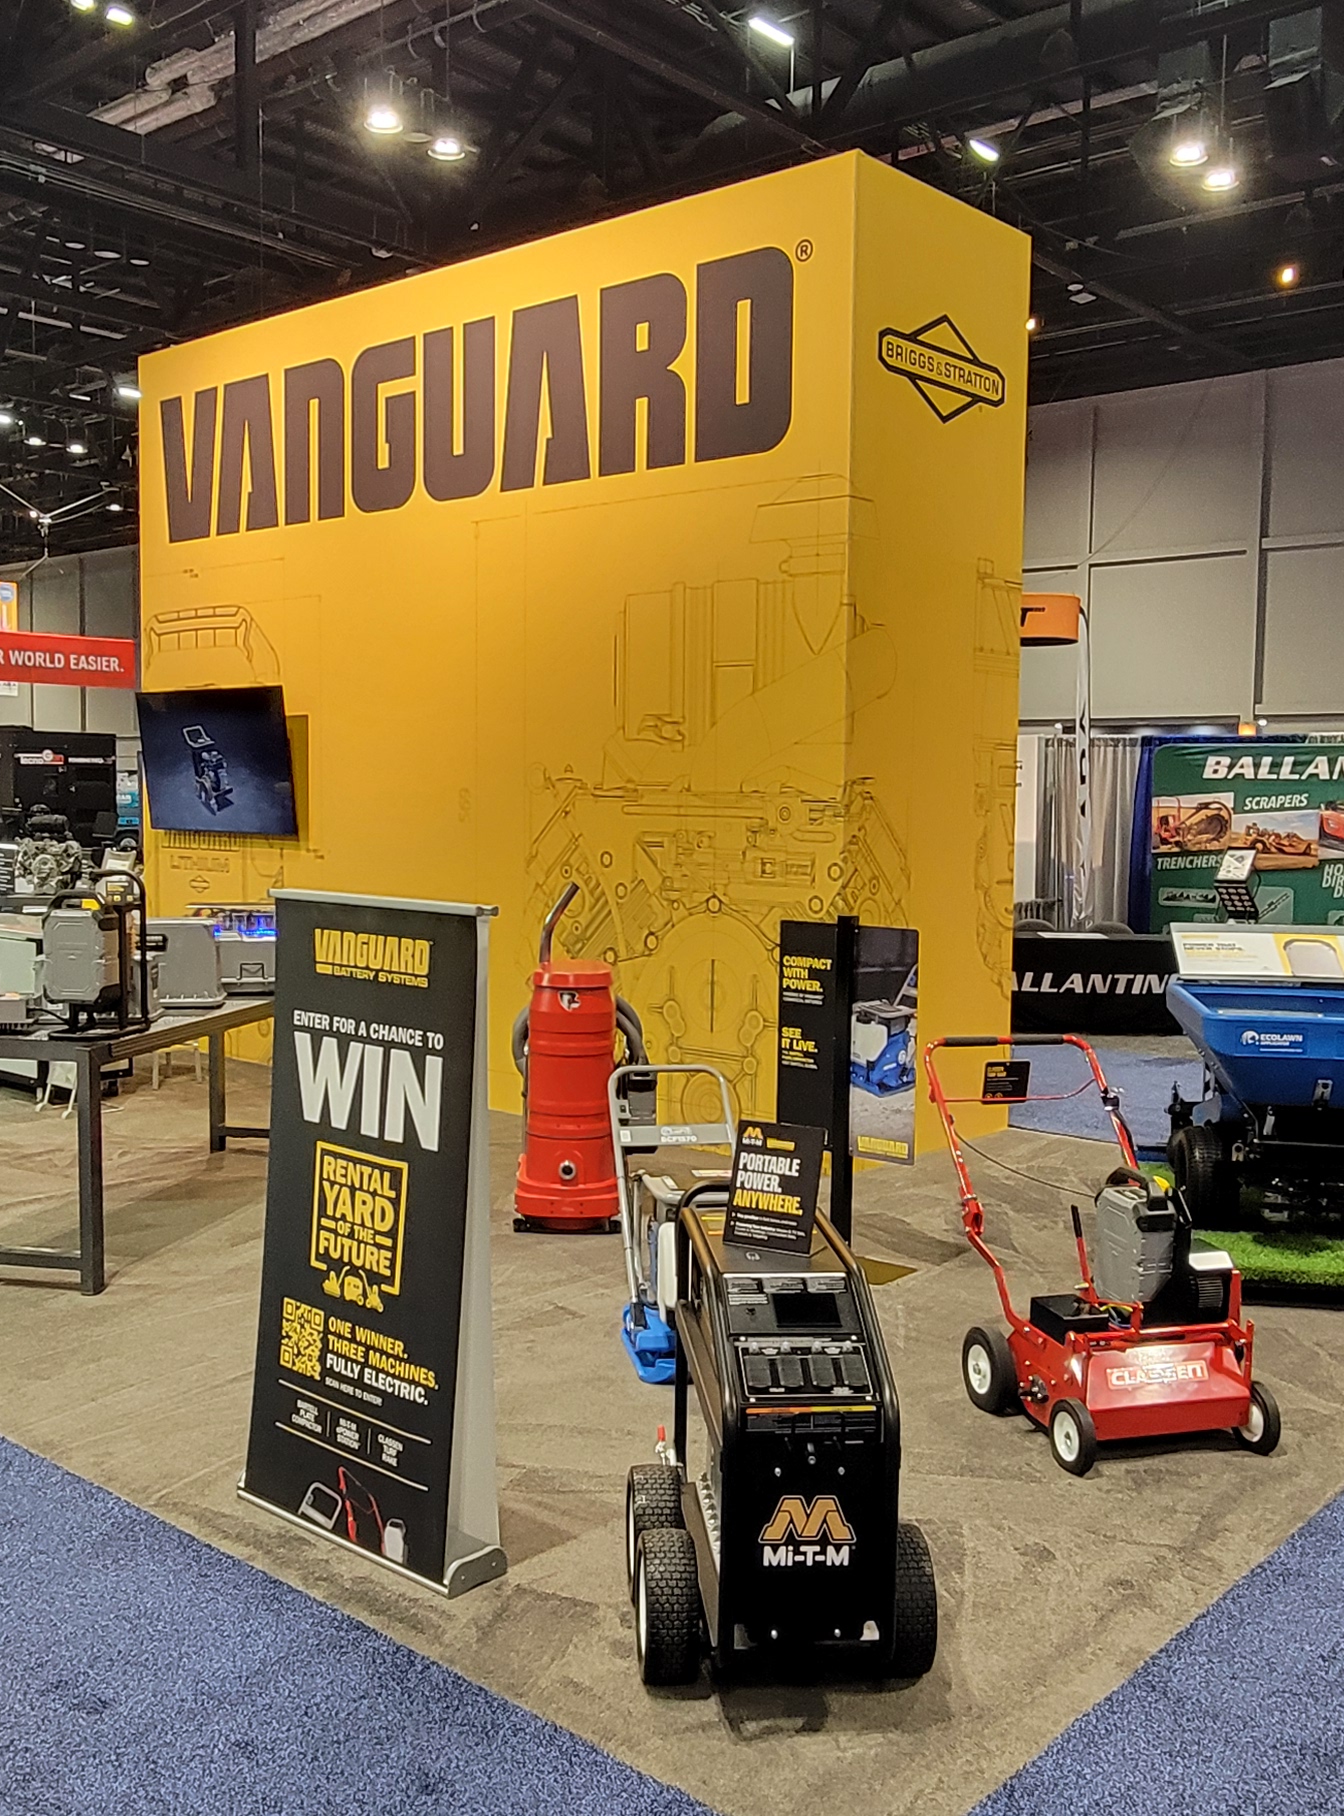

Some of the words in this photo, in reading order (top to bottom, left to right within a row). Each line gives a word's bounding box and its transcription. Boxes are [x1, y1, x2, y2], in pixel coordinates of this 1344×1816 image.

[9, 650, 65, 669] WORLD
[69, 654, 125, 673] EASIER.
[1243, 793, 1309, 811] SCRAPERS
[1157, 853, 1223, 871] TRENCHERS
[313, 928, 431, 976] VANGUARD
[782, 955, 833, 971] COMPACT
[333, 965, 376, 981] BATTERY
[377, 971, 429, 989] SYSTEMS
[782, 966, 809, 979] WITH
[782, 978, 824, 993] POWER.
[293, 1010, 330, 1031] ENTER
[332, 1015, 356, 1035] FOR
[357, 1021, 368, 1038] A
[369, 1020, 424, 1047] CHANCE
[426, 1032, 444, 1050] TO
[781, 1027, 802, 1039] SEE
[1260, 1033, 1303, 1043] ECOLAWN
[781, 1038, 791, 1049] IT
[293, 1030, 444, 1152] WIN
[738, 1151, 801, 1177] PORTABLE
[322, 1155, 396, 1199] RENTAL
[736, 1170, 782, 1194] POWER.
[322, 1180, 395, 1233] YARD
[732, 1188, 803, 1216] ANYWHERE.
[336, 1220, 352, 1236] OF
[353, 1223, 375, 1244] THE
[319, 1229, 393, 1277] FUTURE
[328, 1316, 352, 1340] ONE
[355, 1325, 408, 1359] WINNER.
[328, 1335, 366, 1363] THREE
[368, 1346, 439, 1390] MACHINES.
[324, 1376, 340, 1390] SCAN
[339, 1381, 355, 1396] HERE
[326, 1354, 360, 1381] FULLY
[363, 1367, 429, 1406] ELECTRIC.
[762, 1545, 851, 1567] Mi-T-M
